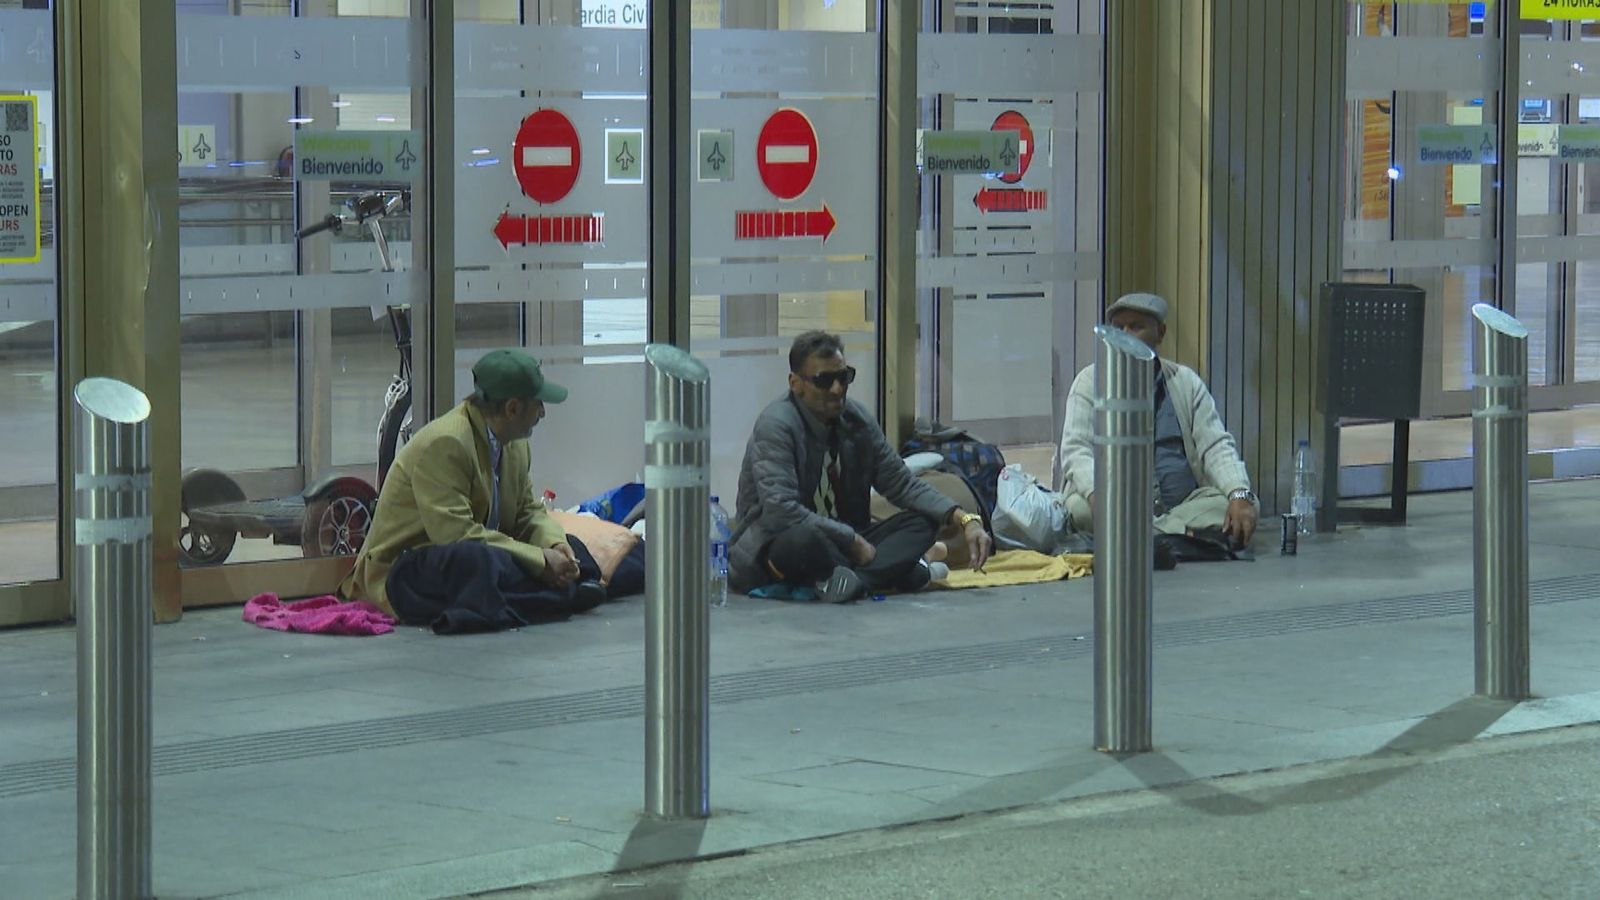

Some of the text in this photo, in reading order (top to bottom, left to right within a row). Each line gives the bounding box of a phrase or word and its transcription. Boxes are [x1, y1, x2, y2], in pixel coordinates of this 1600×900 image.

[1421, 146, 1473, 161] Bienvenido
[302, 157, 384, 175] Bienvenido
[928, 154, 991, 171] Bienvenido
[0, 204, 29, 217] OPEN
